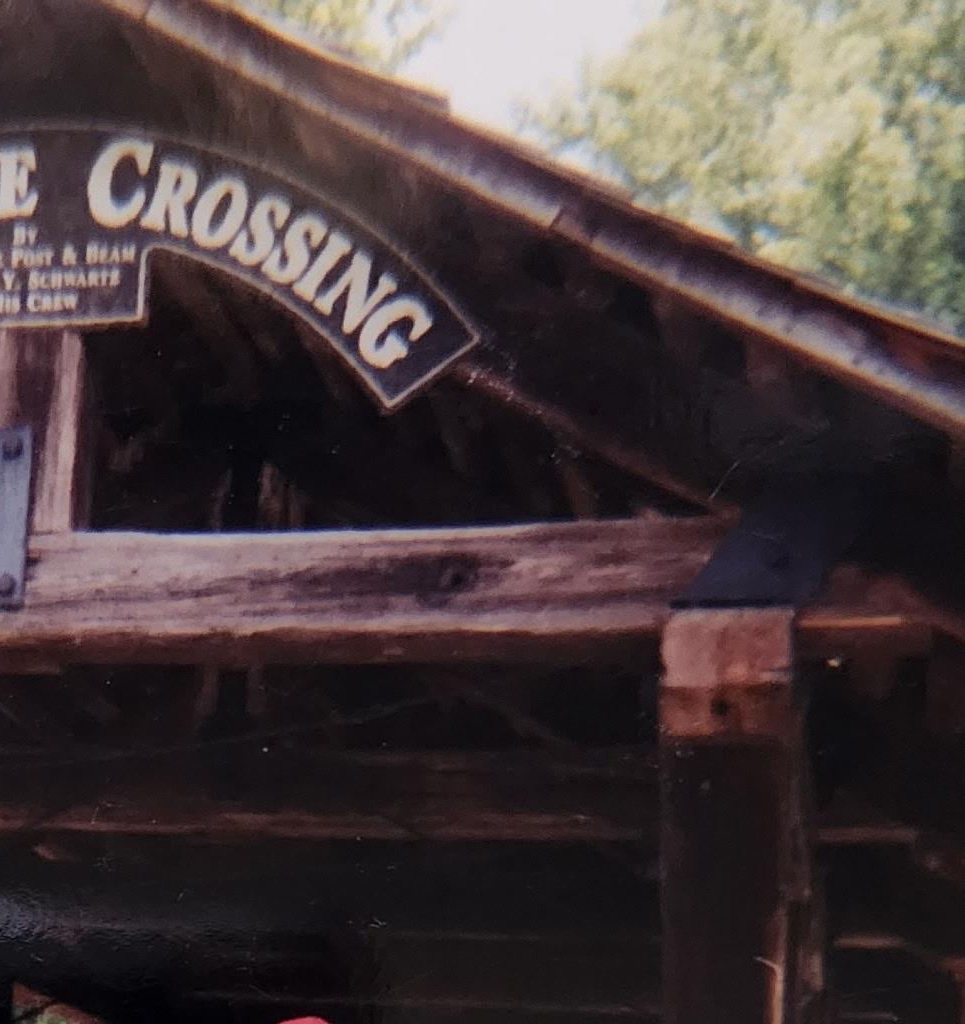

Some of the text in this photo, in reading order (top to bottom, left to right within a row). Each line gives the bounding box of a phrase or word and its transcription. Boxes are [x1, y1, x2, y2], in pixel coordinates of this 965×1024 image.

[13, 225, 38, 246] BY
[62, 243, 77, 266] &
[86, 241, 136, 264] BEAM
[88, 138, 434, 373] CROSSING
[27, 292, 78, 312] CREW
